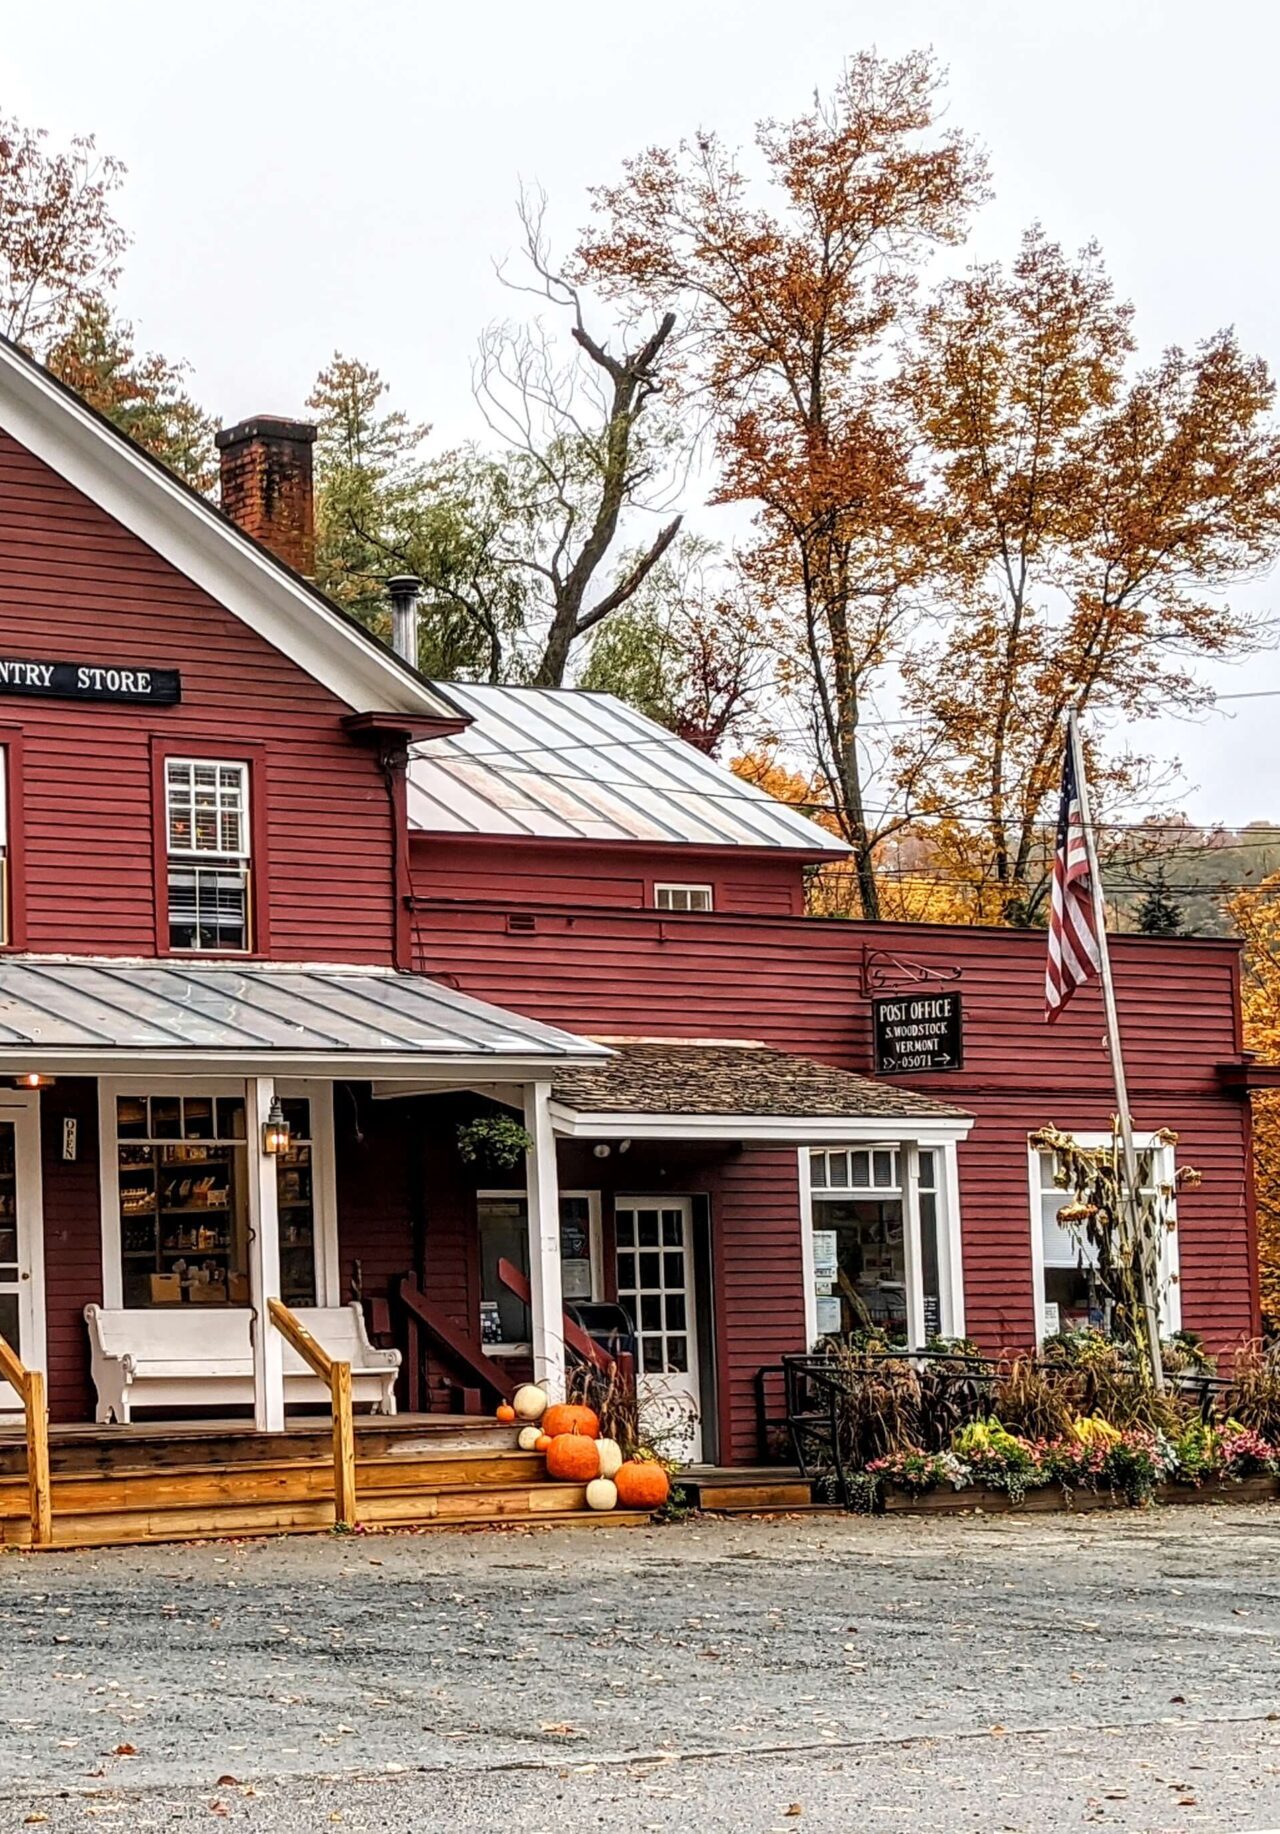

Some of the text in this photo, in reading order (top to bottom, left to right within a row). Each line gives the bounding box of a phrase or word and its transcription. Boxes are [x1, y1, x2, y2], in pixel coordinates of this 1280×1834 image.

[77, 667, 152, 694] STORE
[880, 999, 952, 1022] POST OFFICE
[895, 1038, 939, 1053] VERMONT
[902, 1055, 932, 1068] 05071
[65, 1120, 75, 1158] OPEN
